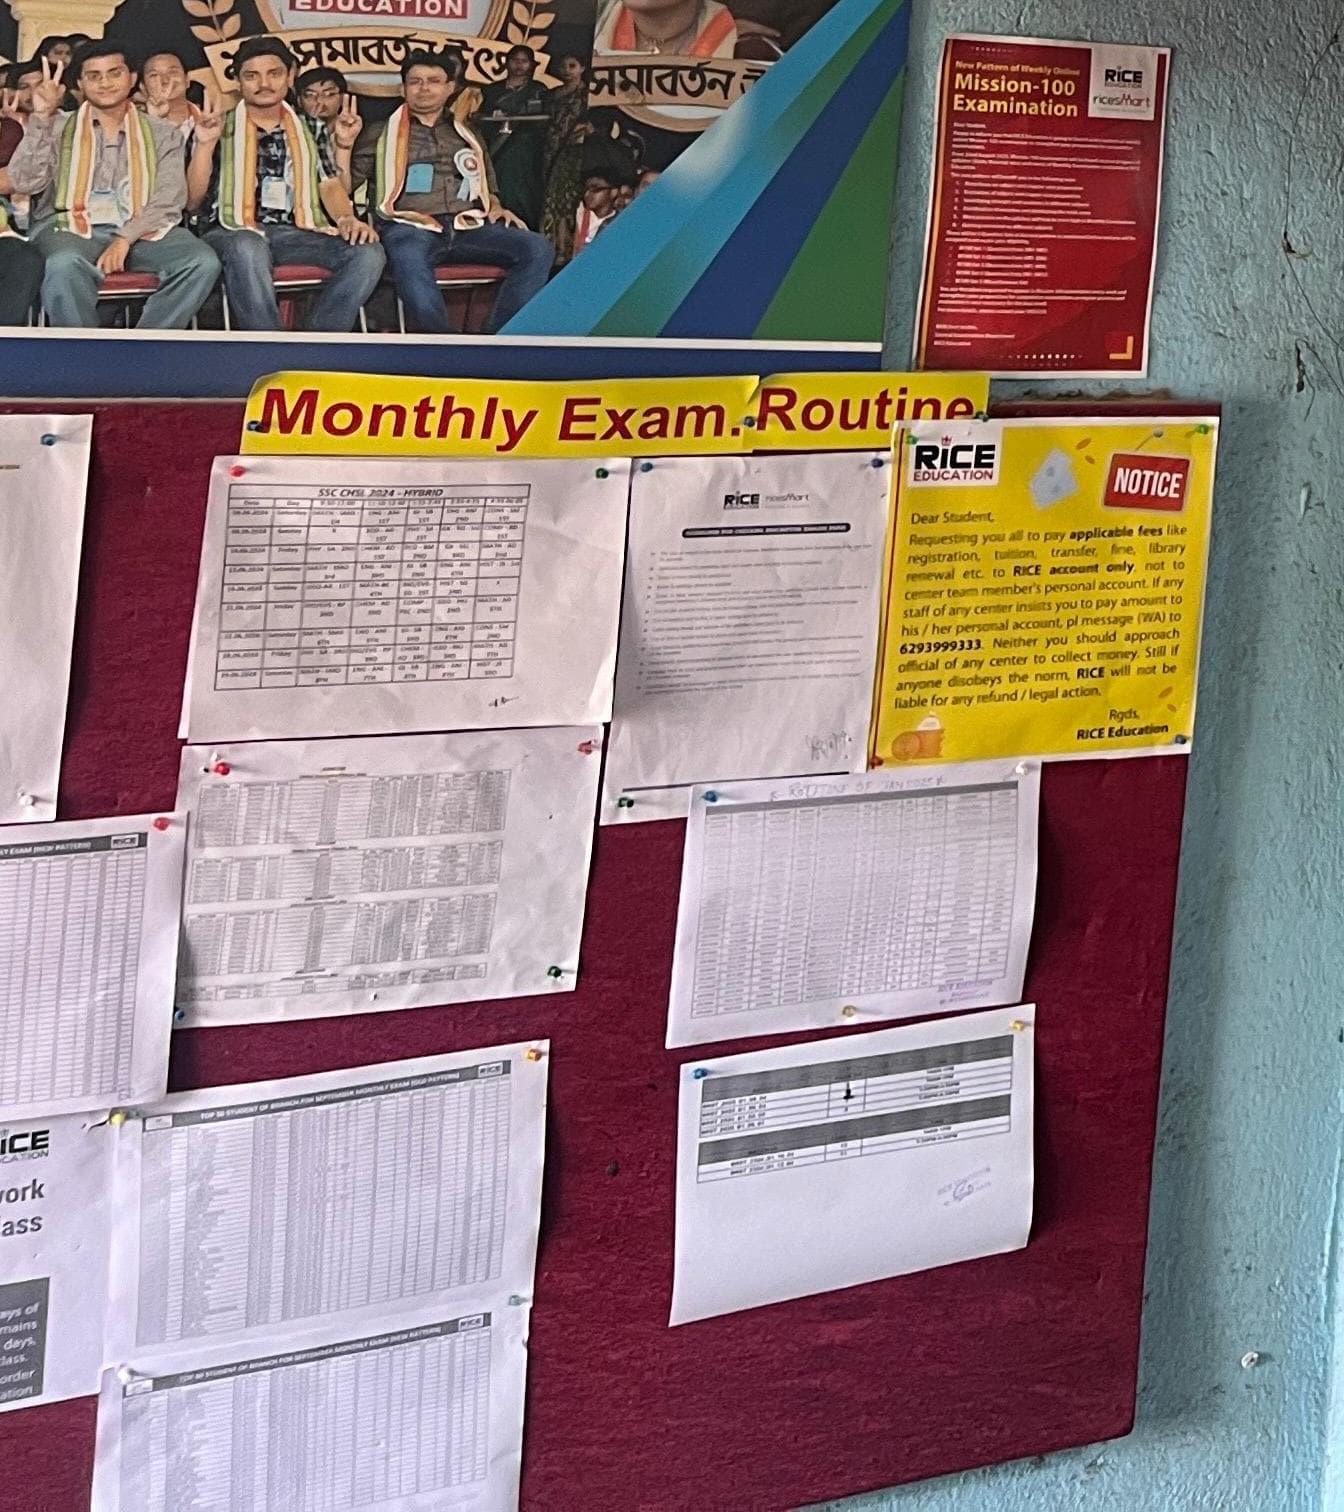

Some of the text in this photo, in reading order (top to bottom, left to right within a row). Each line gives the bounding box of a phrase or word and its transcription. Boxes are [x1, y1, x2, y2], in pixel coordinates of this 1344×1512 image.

[955, 73, 1075, 96] Mission-100
[953, 94, 1078, 116] Examination
[260, 389, 538, 452] Monthly
[558, 395, 743, 441] Exam.
[913, 469, 994, 481] EDUCATION
[1114, 467, 1183, 498] NOTICE
[318, 488, 338, 496] SSC
[404, 489, 443, 497] HYBRID
[911, 512, 939, 525] Dear
[992, 637, 1038, 650] Neither
[1045, 635, 1068, 649] you
[1076, 631, 1116, 644] should
[1124, 628, 1180, 643] approach
[895, 677, 943, 692] anyone
[947, 673, 1002, 688] disobeys
[1008, 672, 1029, 684] the
[1076, 667, 1105, 679] RICE
[1110, 665, 1131, 677] will
[1137, 665, 1156, 675] not
[1162, 662, 1176, 674] be
[894, 694, 929, 709] liable
[930, 693, 949, 706] for
[951, 692, 974, 706] any
[976, 689, 1018, 703] refund
[1028, 686, 1059, 701] legal
[1076, 723, 1168, 741] RICE Education
